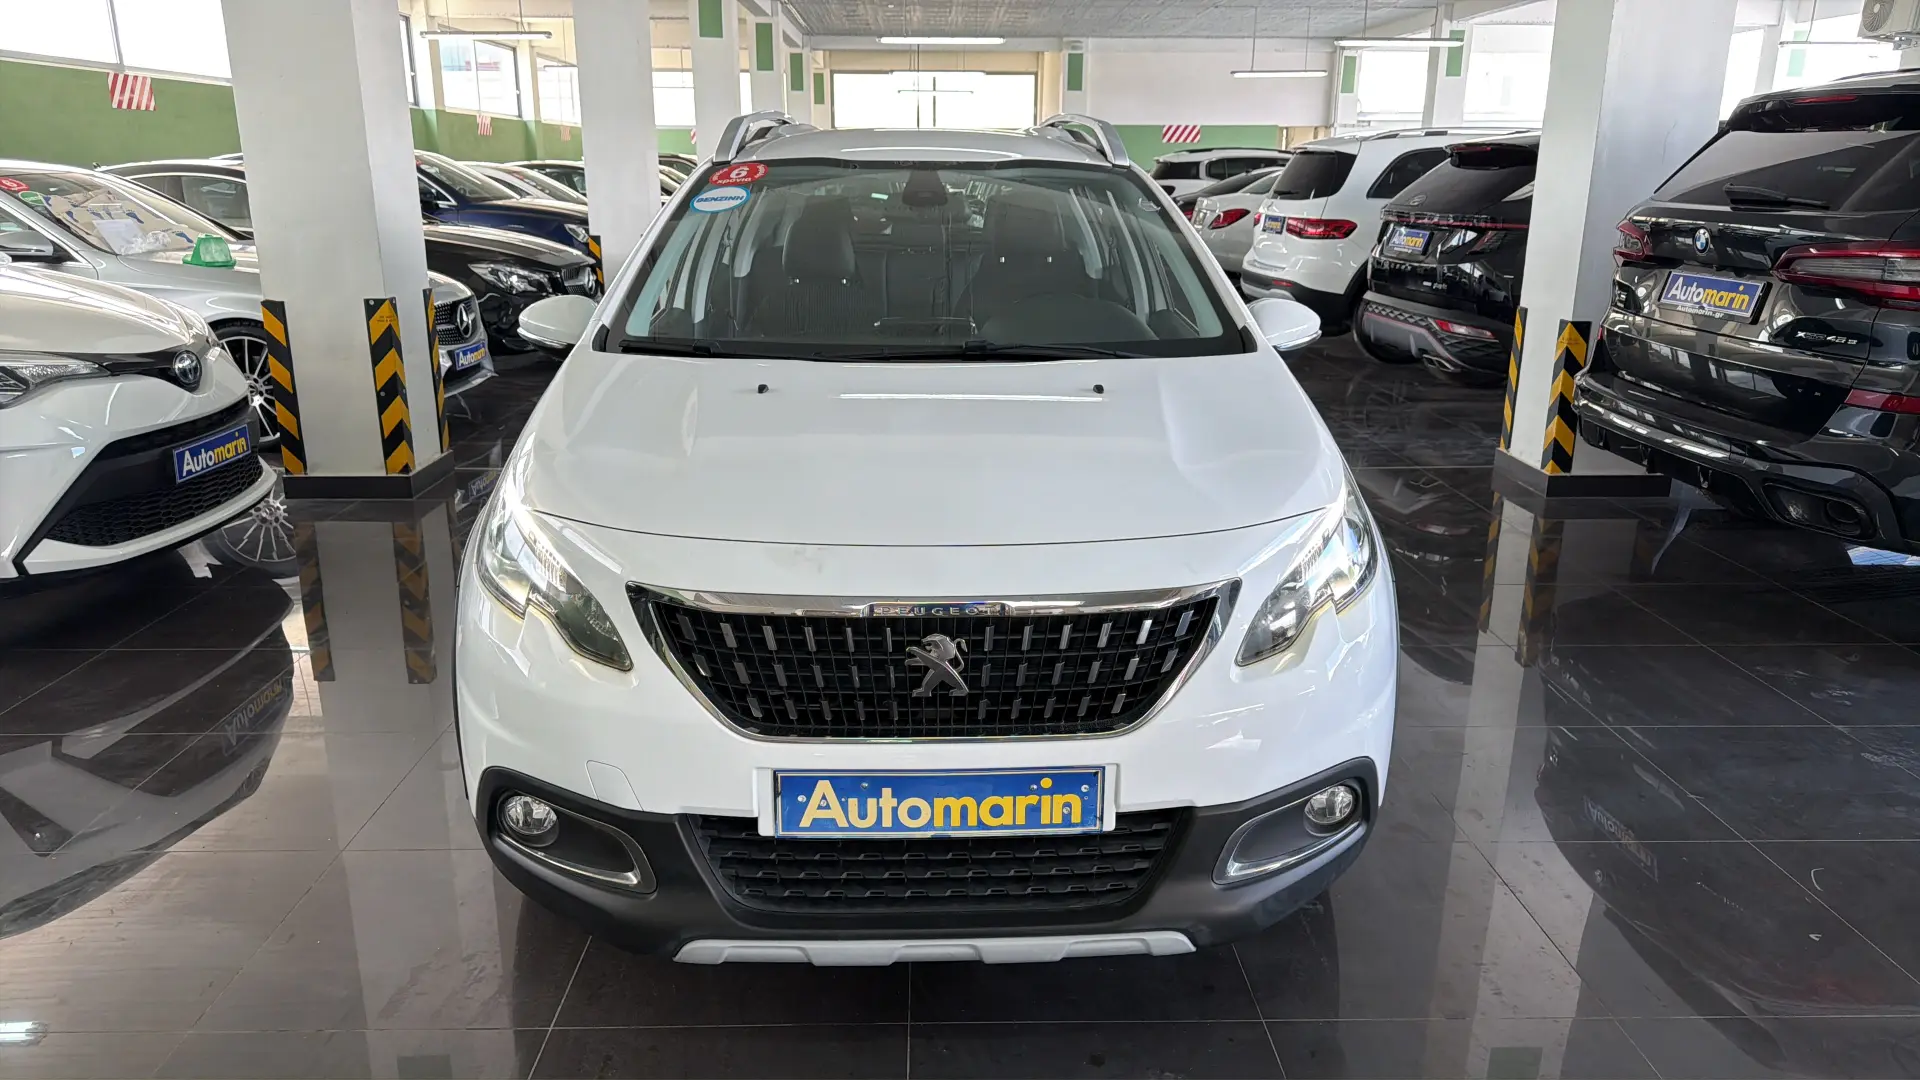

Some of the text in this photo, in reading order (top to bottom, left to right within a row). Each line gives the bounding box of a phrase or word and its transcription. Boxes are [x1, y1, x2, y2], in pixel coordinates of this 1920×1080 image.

[729, 166, 750, 179] 6
[1667, 276, 1750, 310] Automarin
[1676, 305, 1725, 318] Automarin.gr
[182, 431, 247, 477] Automarin
[880, 606, 997, 616] PEUGEOT
[798, 777, 1082, 828] Automarin
